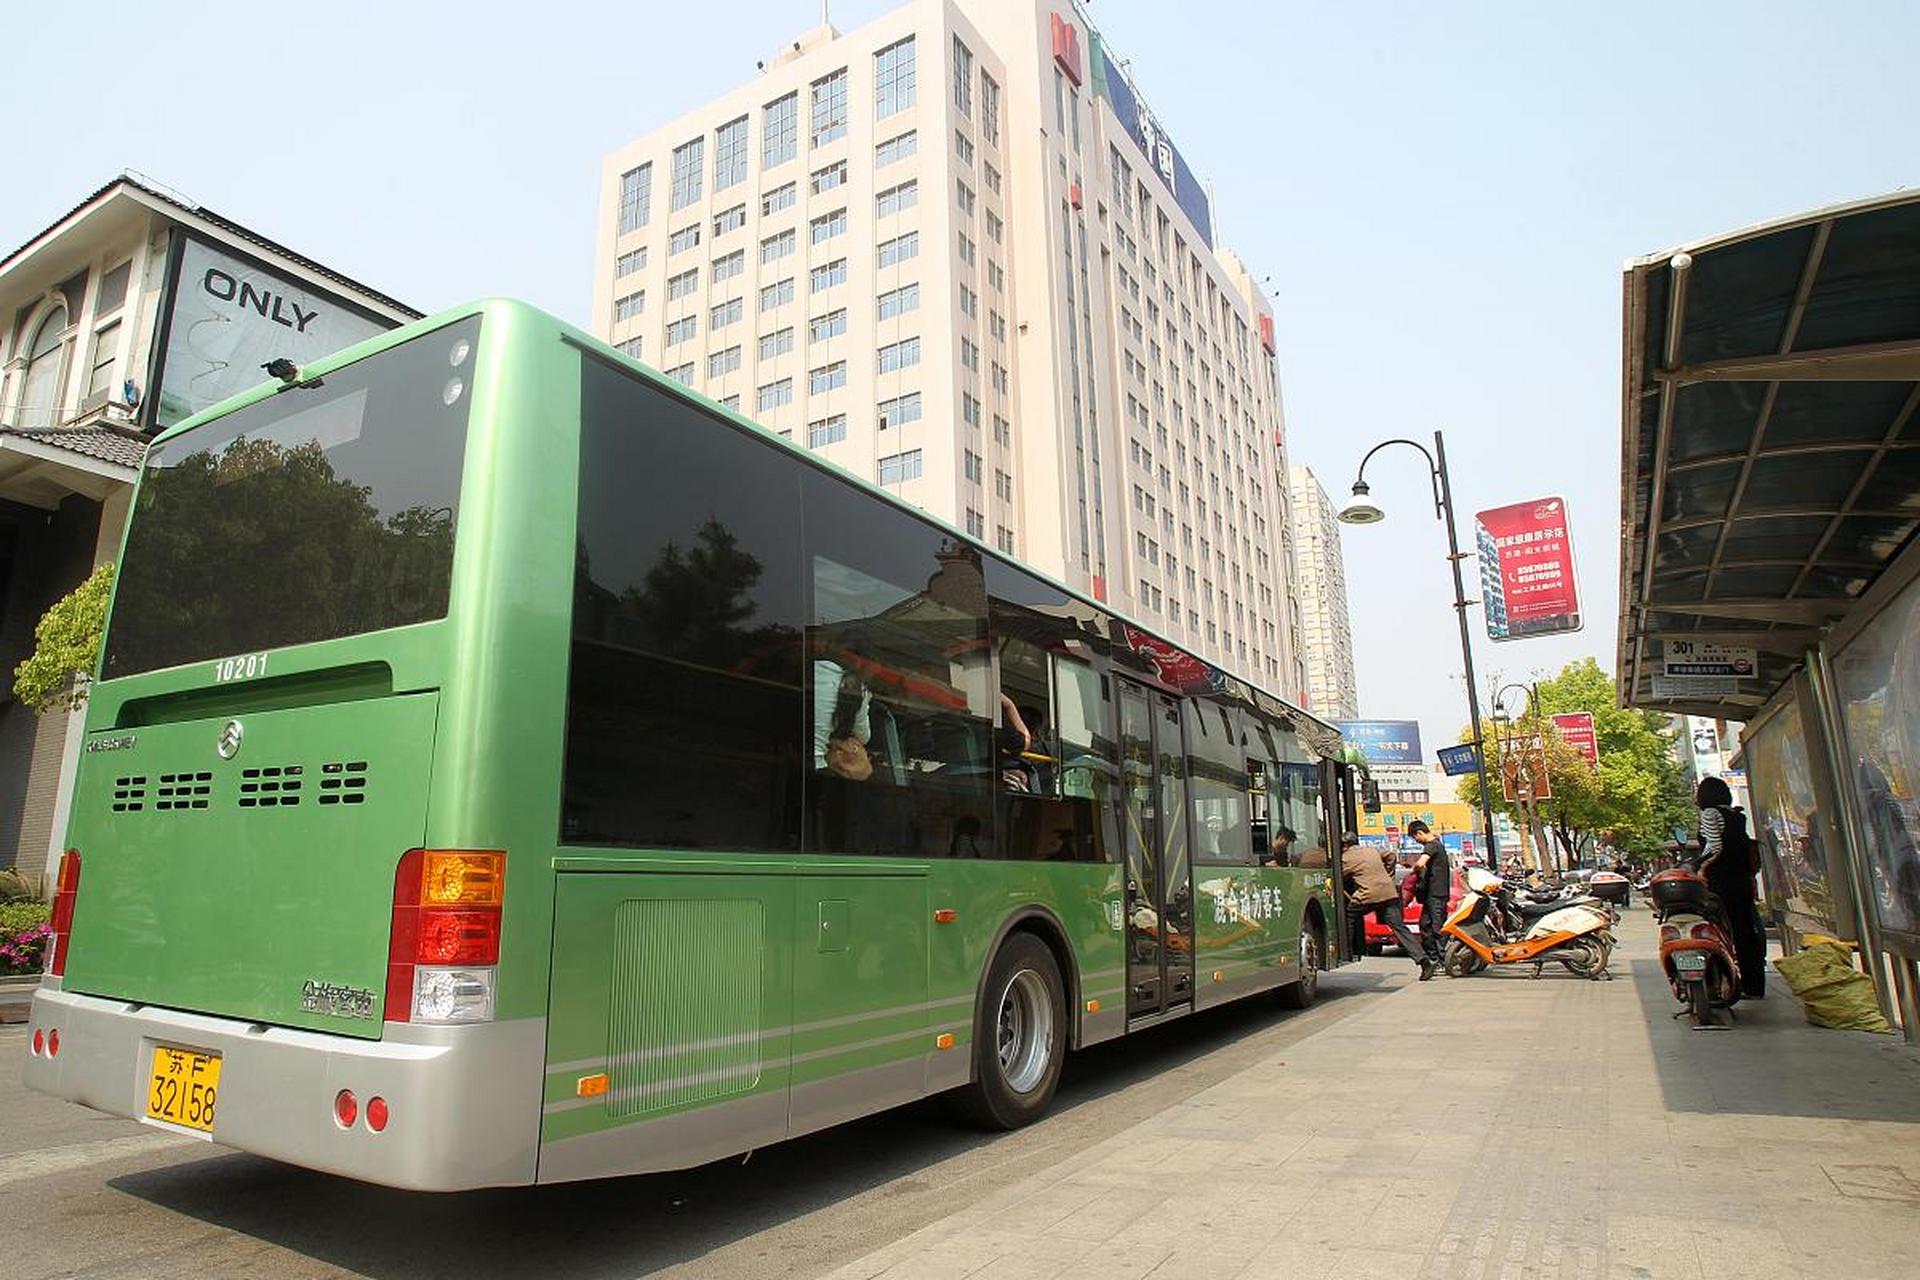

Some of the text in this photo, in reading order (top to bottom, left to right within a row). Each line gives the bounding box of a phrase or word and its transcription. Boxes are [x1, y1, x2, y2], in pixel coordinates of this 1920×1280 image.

[204, 268, 319, 333] ONLY
[1673, 641, 1694, 654] 301
[216, 653, 268, 682] 10201
[151, 1075, 216, 1125] 32158
